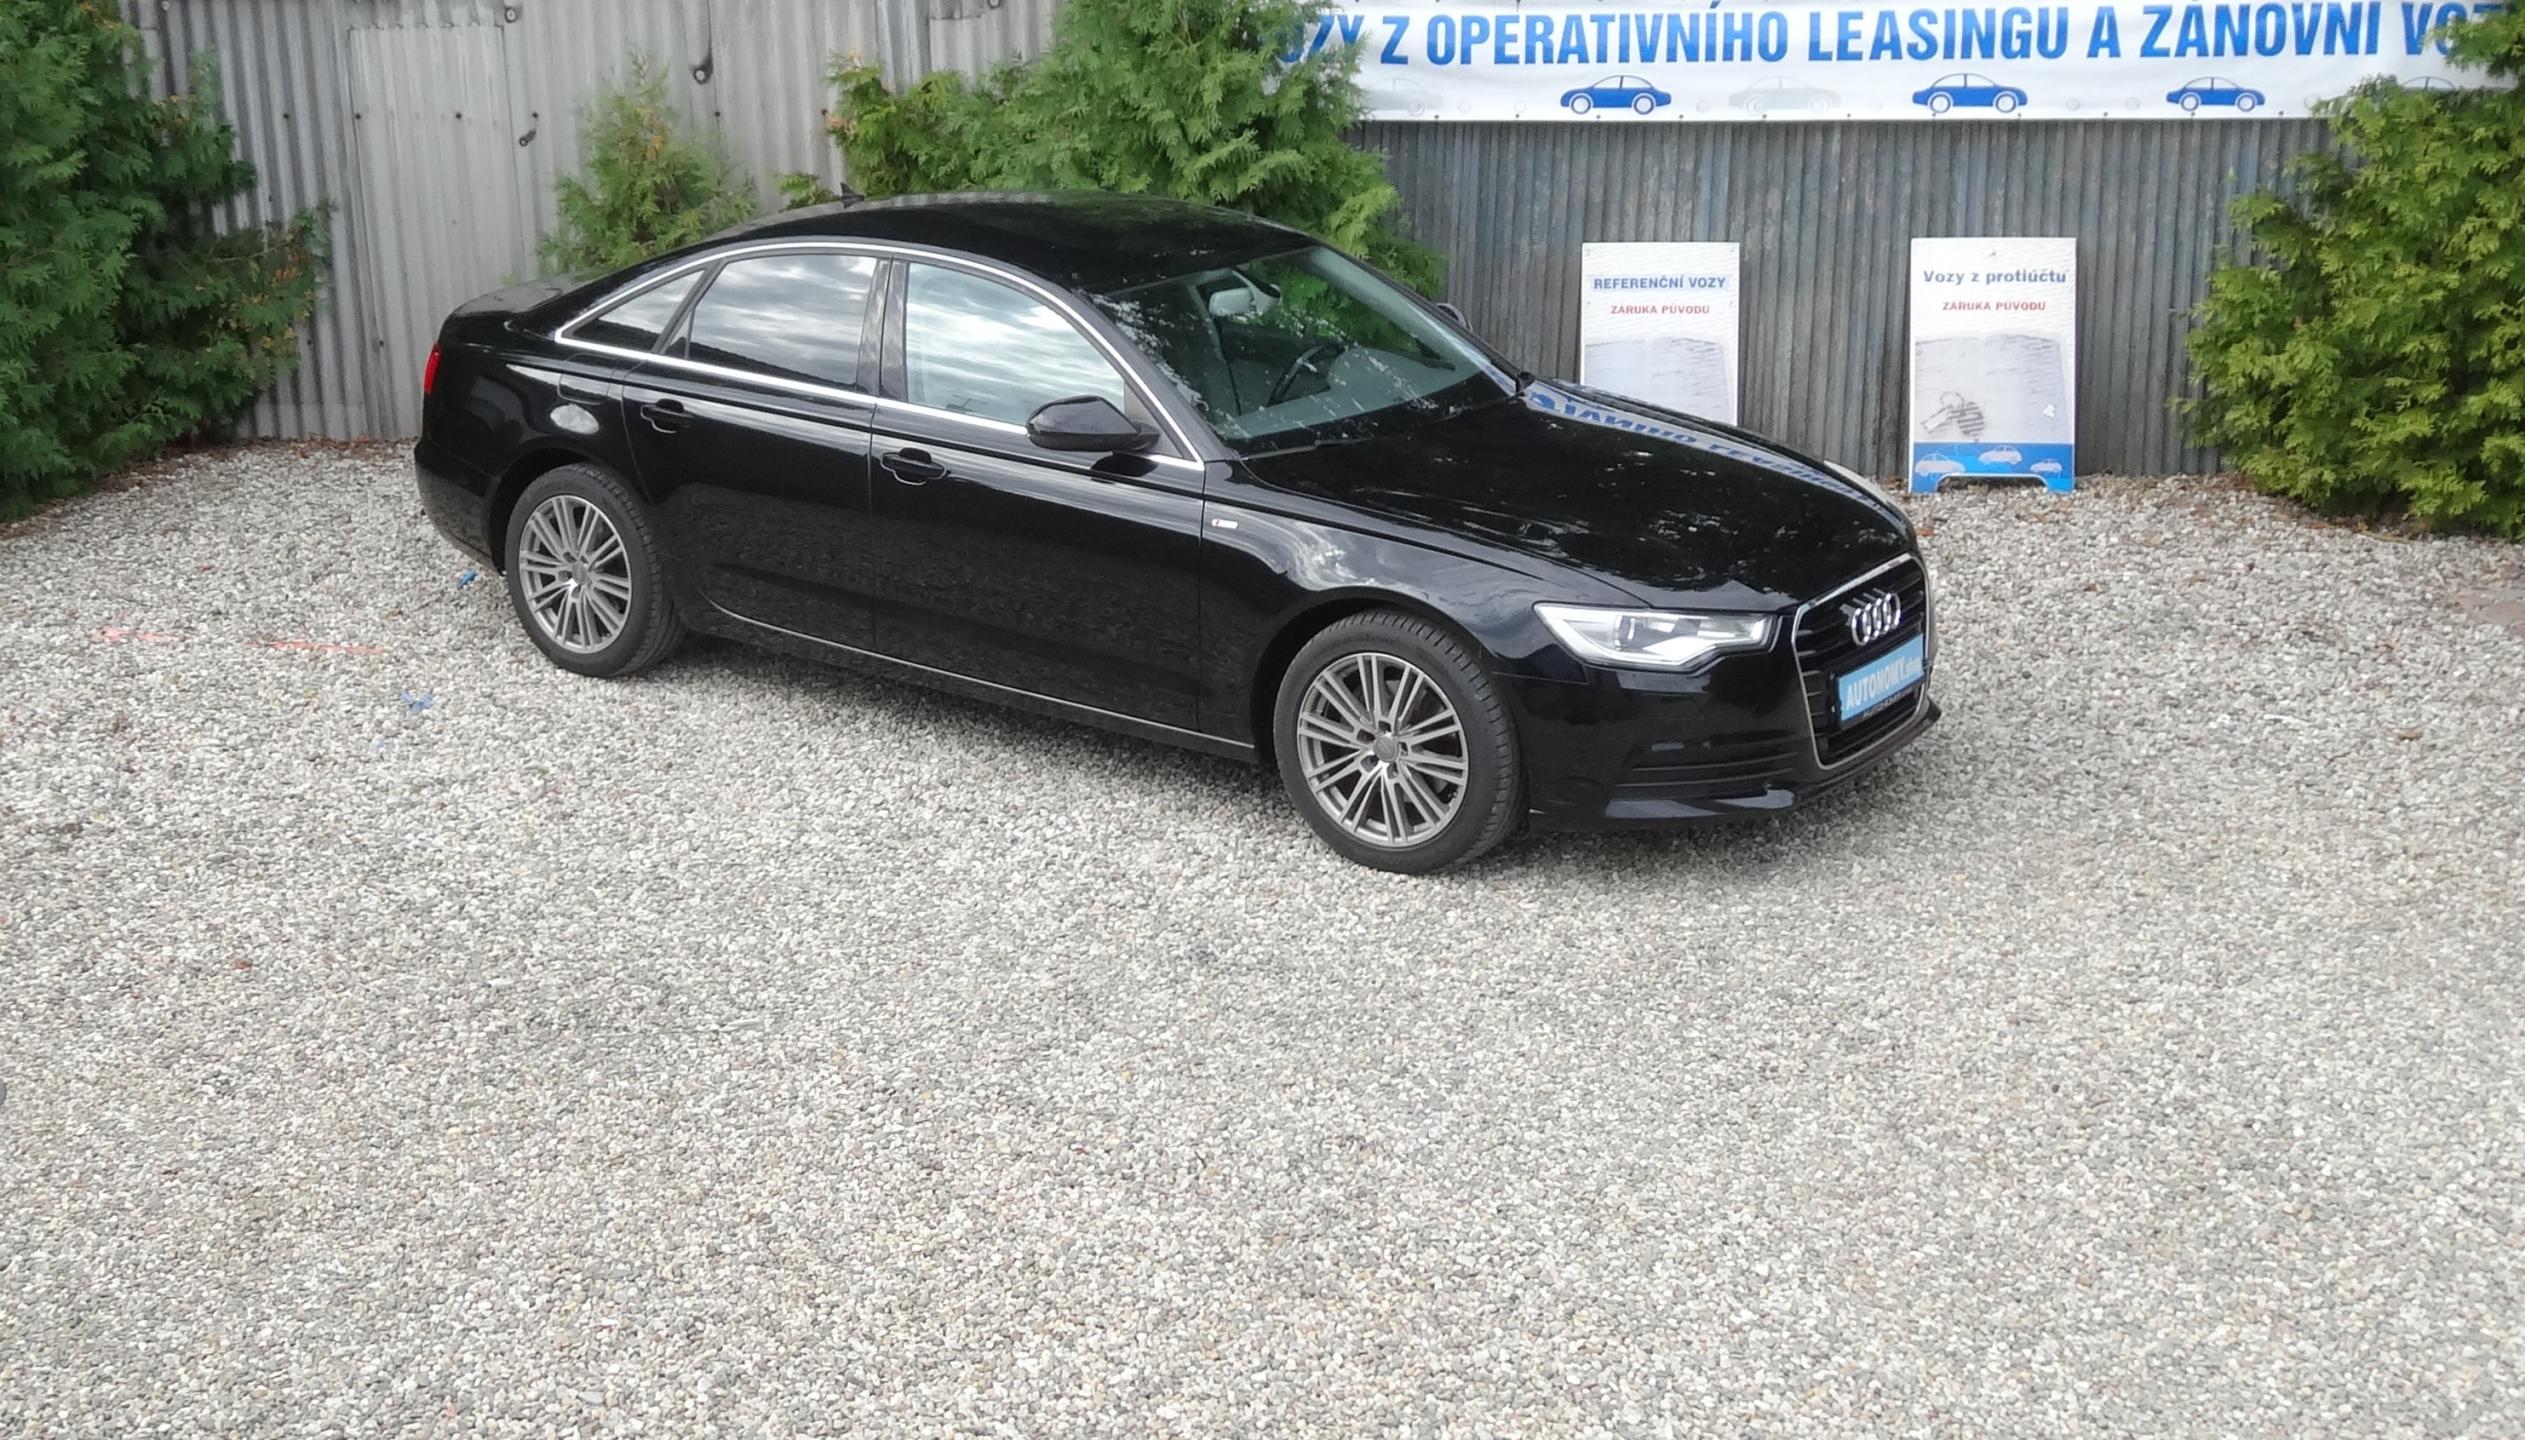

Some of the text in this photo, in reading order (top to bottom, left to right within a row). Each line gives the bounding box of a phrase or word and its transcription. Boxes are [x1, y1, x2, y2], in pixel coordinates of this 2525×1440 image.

[1380, 15, 1410, 65] Z
[1426, 0, 1788, 65] OPERATIVNÍHO
[1807, 7, 2069, 61] LEASINGU
[2086, 6, 2121, 58] A
[1594, 274, 1727, 289] REFERENČNÍ VOZY
[1923, 270, 1965, 285] Vozy
[1971, 273, 1980, 282] z
